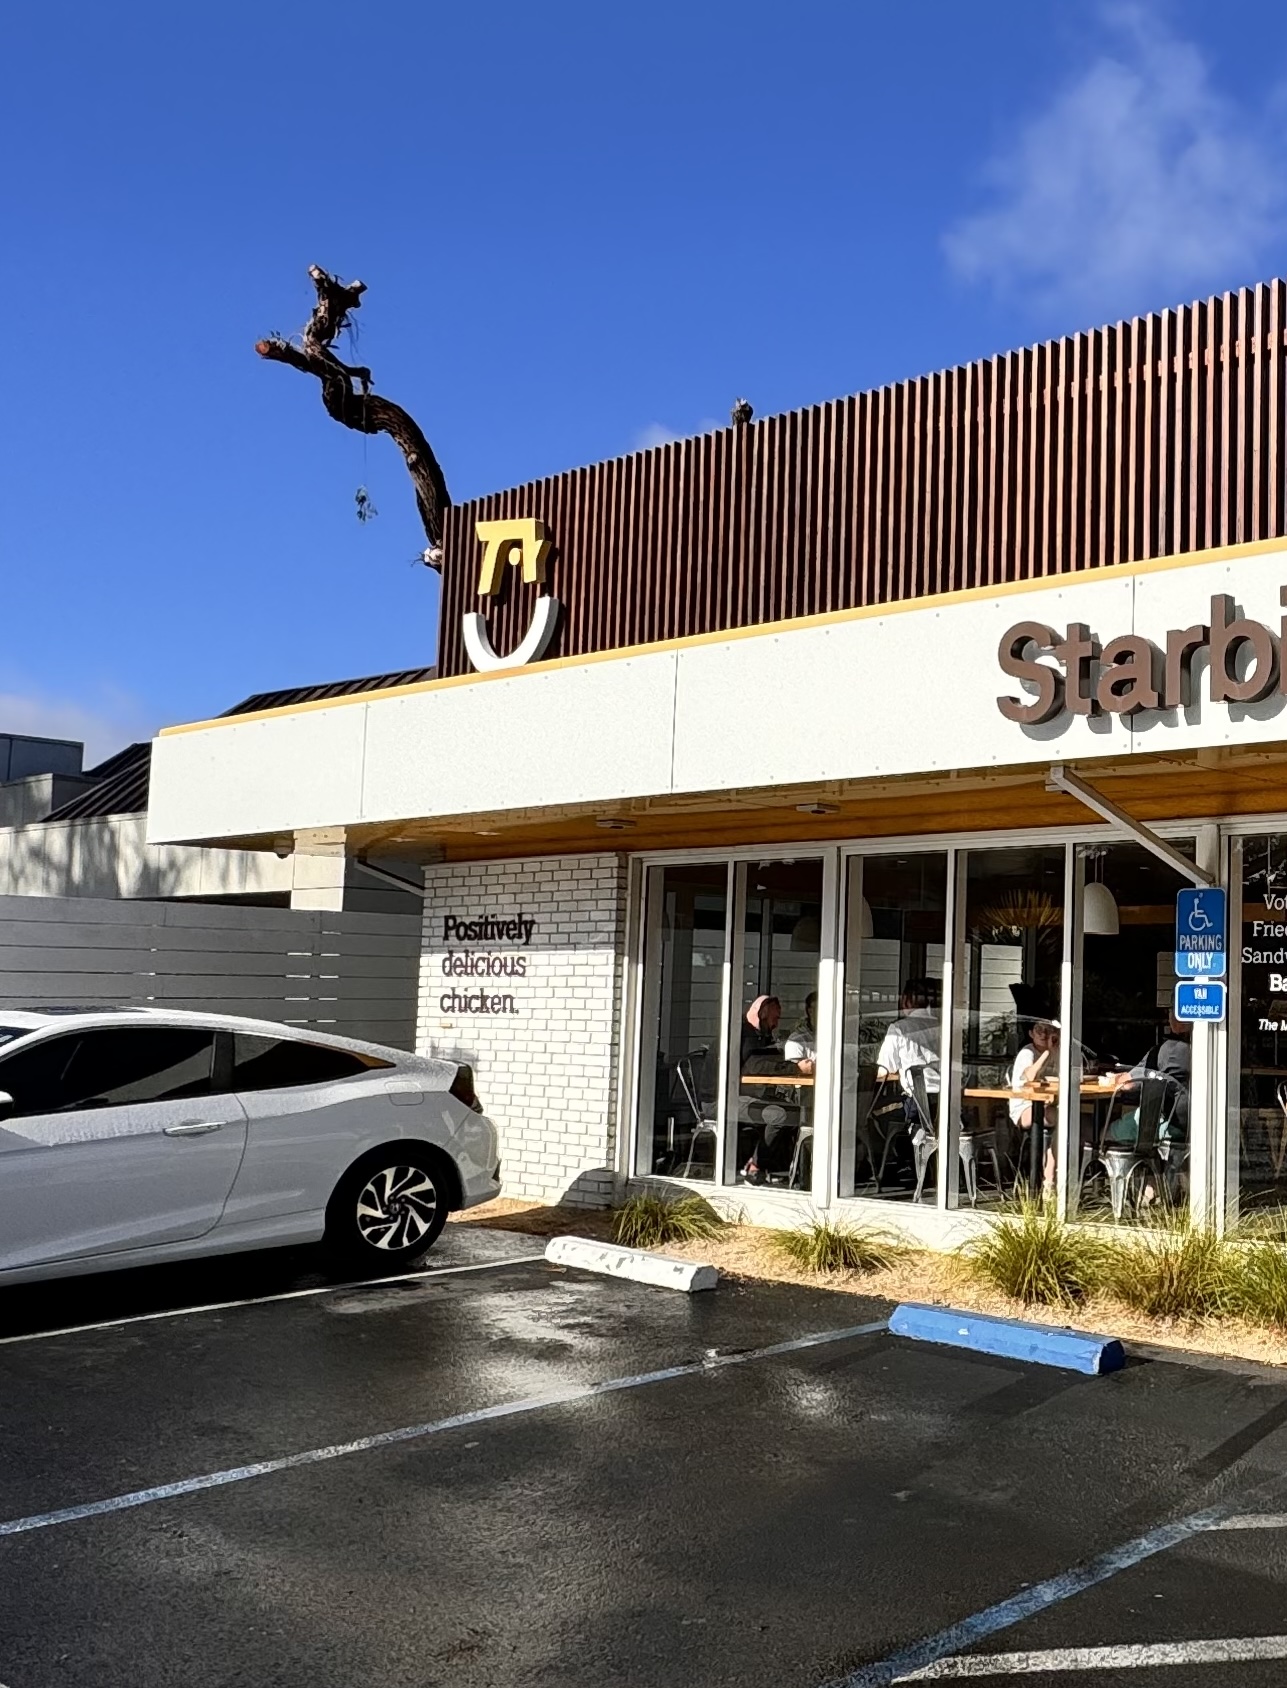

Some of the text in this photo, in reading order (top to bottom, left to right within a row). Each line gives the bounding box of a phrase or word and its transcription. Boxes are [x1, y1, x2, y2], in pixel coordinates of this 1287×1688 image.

[443, 913, 536, 945] Positively
[1179, 934, 1222, 951] PARKING
[442, 949, 527, 977] delicious
[1187, 952, 1214, 970] ONLY
[440, 987, 520, 1014] chicken.
[1193, 988, 1208, 1000] VAN
[1180, 1004, 1220, 1016] ACCESSIBLE
[1258, 1018, 1278, 1032] The
